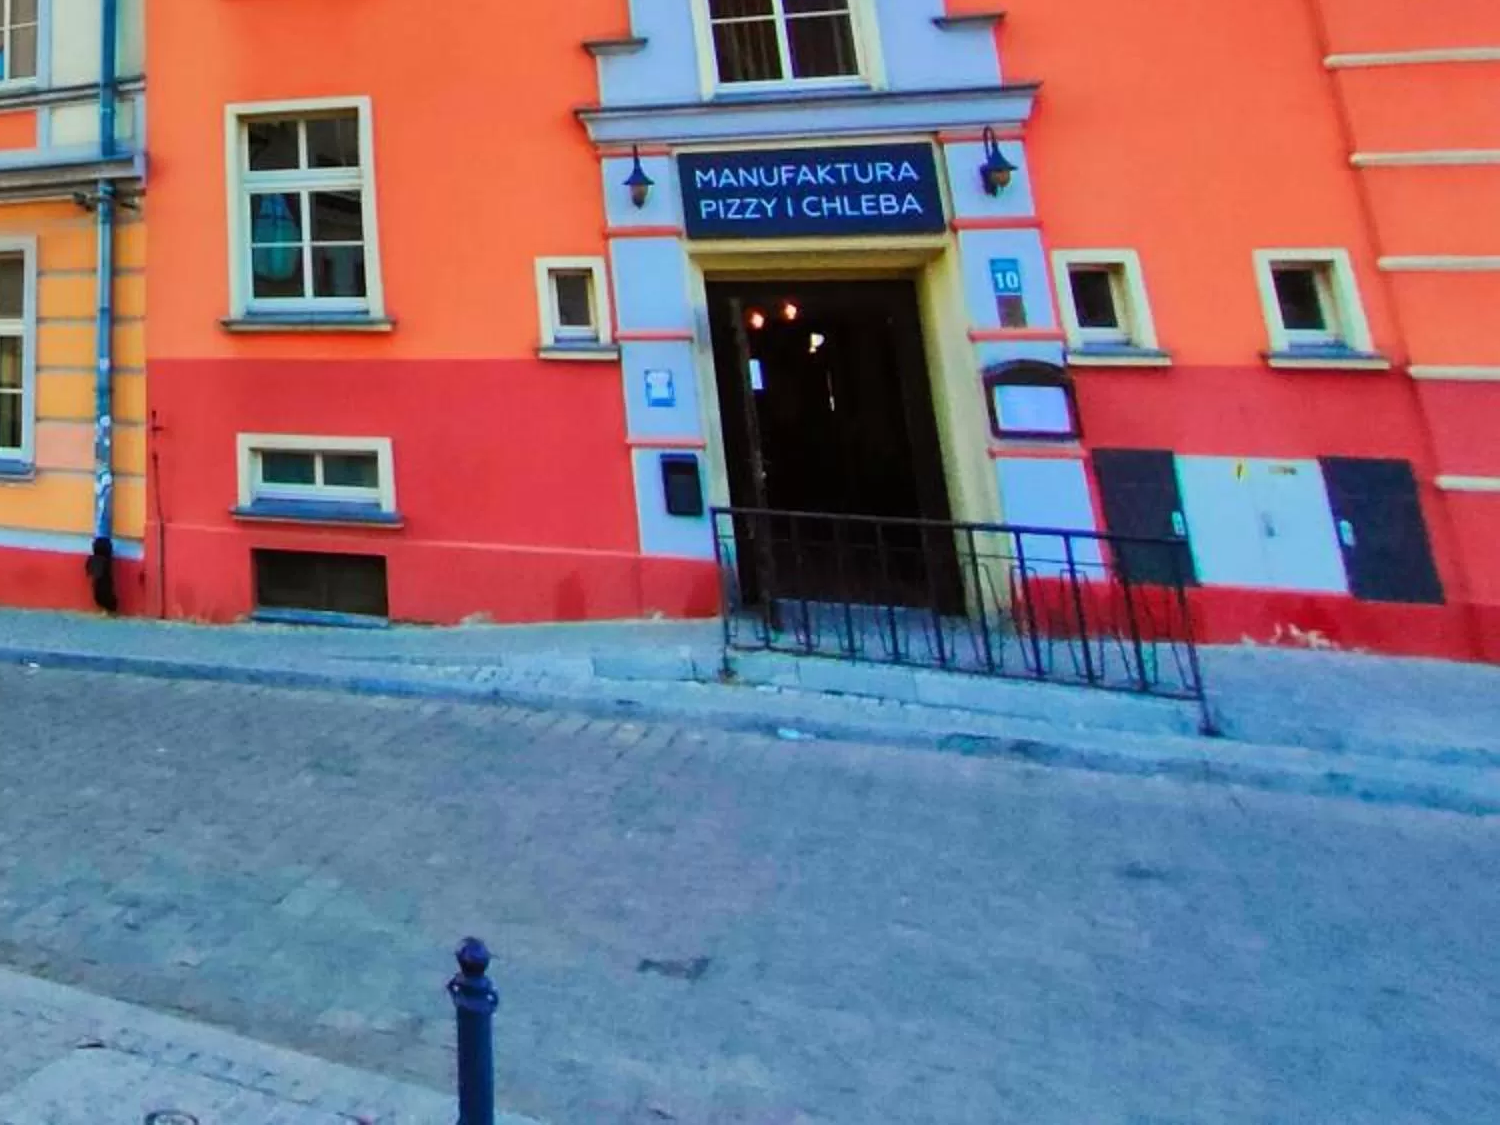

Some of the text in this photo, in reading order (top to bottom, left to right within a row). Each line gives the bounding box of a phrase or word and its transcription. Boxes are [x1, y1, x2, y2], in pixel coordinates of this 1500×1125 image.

[695, 161, 920, 188] MANUFAKTURA
[700, 193, 924, 219] PIZZY I CHLEBA
[995, 270, 1019, 289] 10
